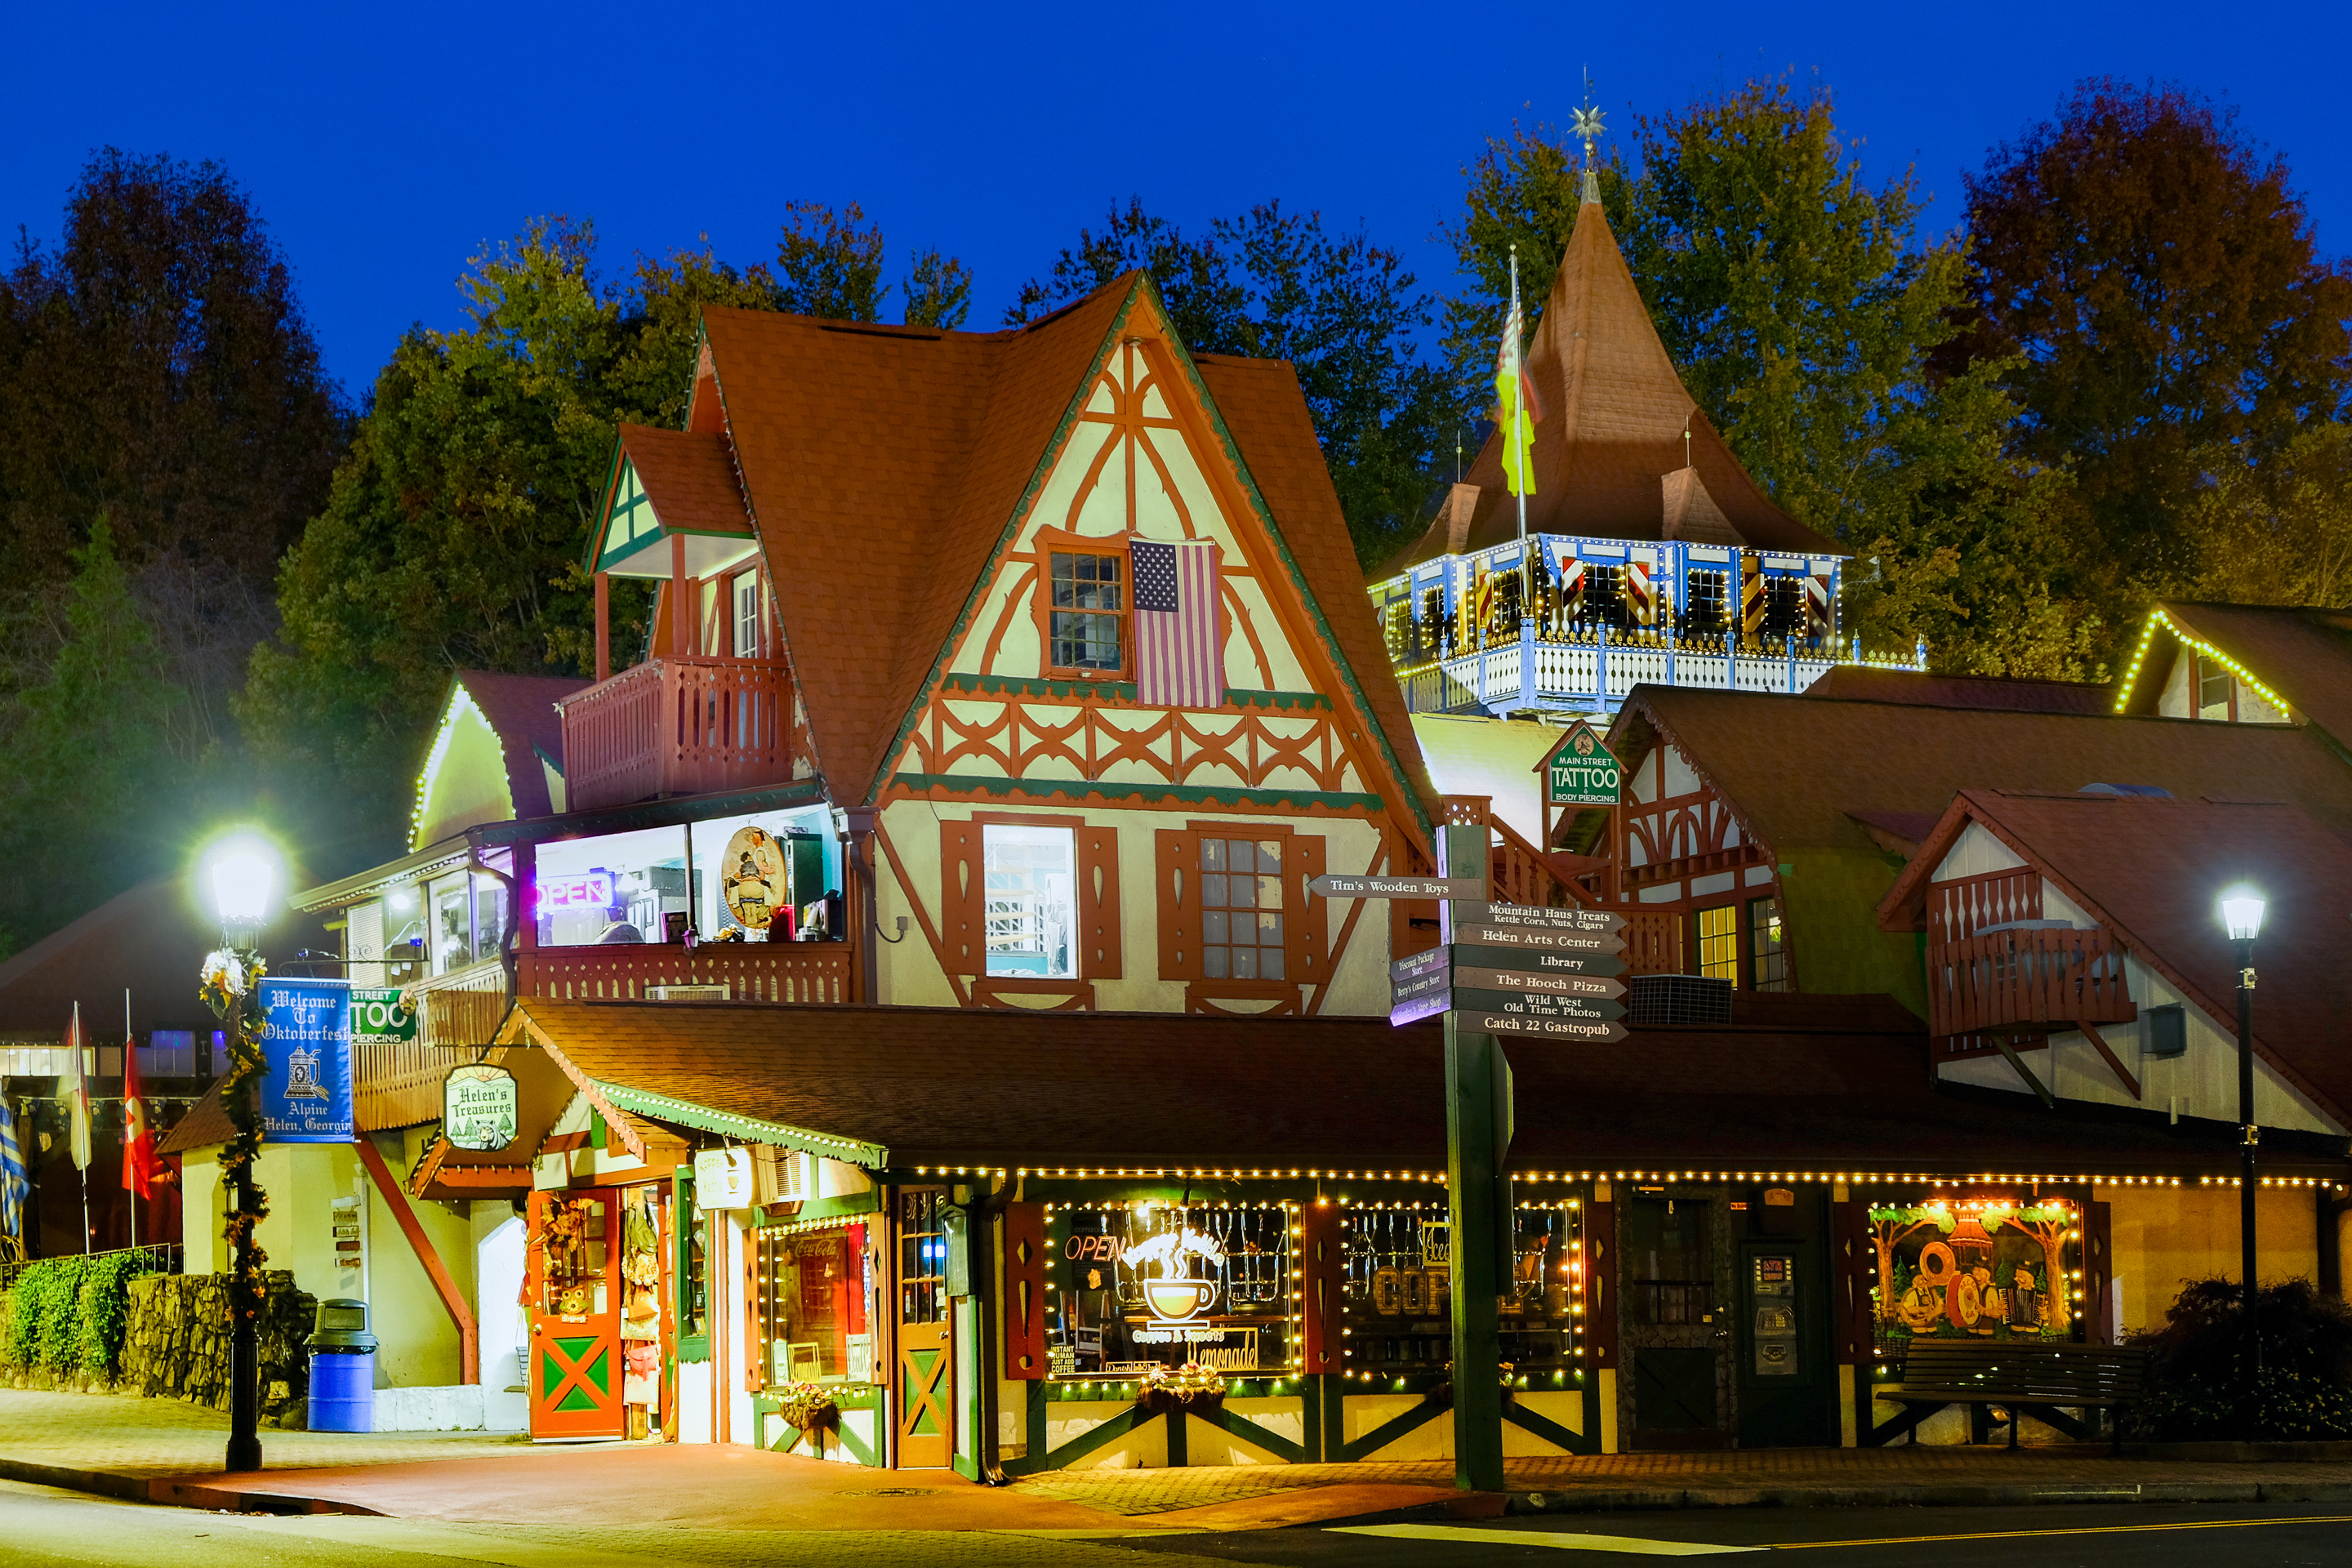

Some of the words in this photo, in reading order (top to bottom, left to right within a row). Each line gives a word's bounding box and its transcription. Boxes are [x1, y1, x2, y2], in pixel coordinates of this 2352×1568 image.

[1559, 756, 1581, 765] MAIN
[1582, 757, 1612, 766] STREET
[1552, 767, 1618, 788] TATTOO
[1556, 793, 1577, 801] BODY
[1578, 794, 1615, 803] PIERCING
[1330, 880, 1364, 891] Tim's
[1369, 880, 1419, 893] Wooden
[1423, 883, 1450, 896] Toys
[1488, 904, 1540, 917] Mountain
[1544, 908, 1573, 920] Haus
[1576, 911, 1610, 922] Treats
[1494, 915, 1520, 924] Kettle
[1523, 917, 1548, 927] Corn,
[1551, 919, 1574, 929] Nuts,
[1576, 920, 1604, 931] Cigars
[1482, 930, 1518, 942] Helen
[1524, 933, 1552, 945] Arts
[1557, 936, 1601, 948] Center
[1399, 958, 1417, 971] Discount
[1417, 952, 1435, 964] Package
[1540, 956, 1584, 970] Library
[1411, 966, 1423, 976] Store
[1412, 980, 1428, 992] Country
[1429, 975, 1441, 987] Store
[1496, 974, 1521, 986] The
[1526, 977, 1567, 990] Hooch
[1572, 981, 1607, 993] Pizza
[270, 989, 336, 1009] Welcome
[352, 990, 392, 1000] STREET
[1524, 994, 1551, 1005] Wild
[1556, 996, 1582, 1007] West
[292, 1007, 316, 1024] To
[350, 1001, 408, 1027] TOO
[1503, 1002, 1524, 1013] Old
[1529, 1004, 1558, 1015] Time
[1563, 1006, 1601, 1018] Photos
[1484, 1017, 1521, 1030] Catch
[1526, 1019, 1540, 1031] 22
[1544, 1021, 1610, 1038] Gastropub
[350, 1033, 401, 1043] PIERCING
[459, 1087, 507, 1103] Helen's
[287, 1101, 328, 1119] Alpine
[451, 1103, 512, 1118] Treasures
[264, 1116, 302, 1132] Helen,
[1065, 1236, 1127, 1262] OPEN
[1374, 1266, 1524, 1316] COFE
